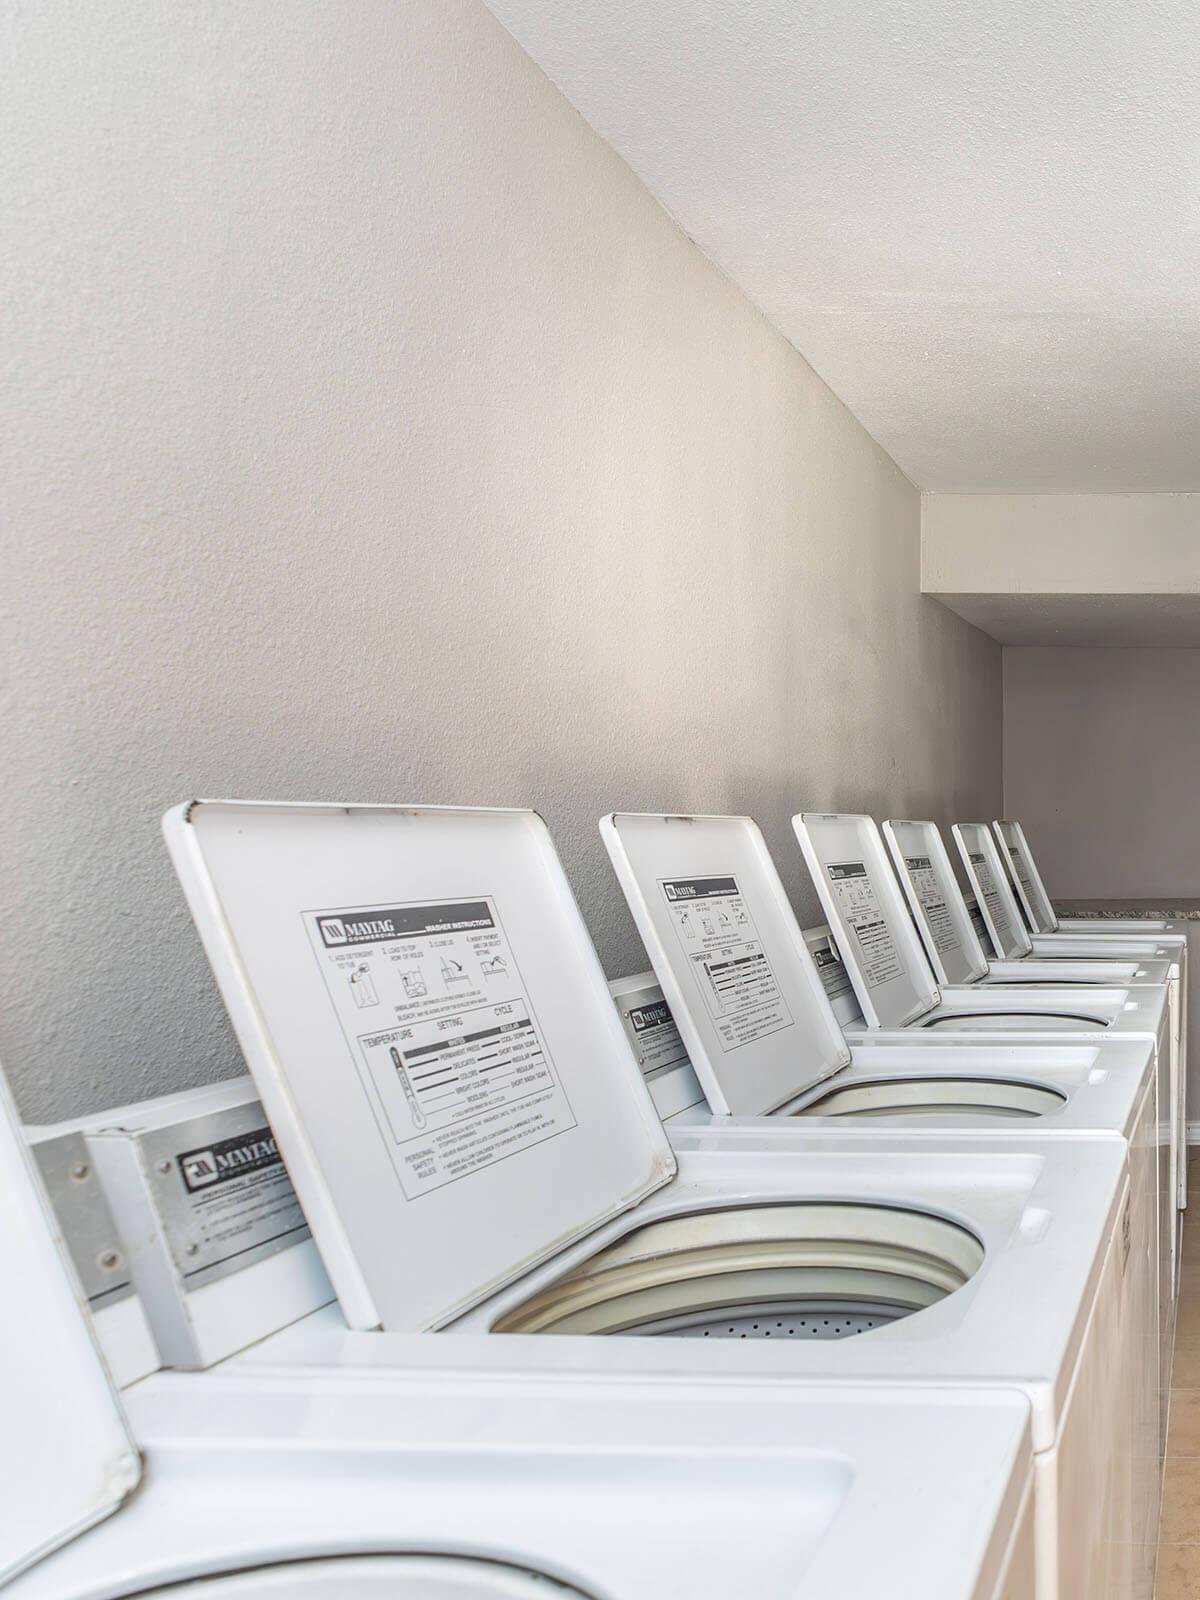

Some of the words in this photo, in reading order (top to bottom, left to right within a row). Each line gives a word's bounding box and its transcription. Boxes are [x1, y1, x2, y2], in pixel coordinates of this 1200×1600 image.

[344, 919, 395, 936] MAYTAG
[424, 923, 451, 932] WASHER
[451, 918, 492, 929] INSTRUCTIONS
[492, 1004, 513, 1016] CYCLE
[436, 1016, 463, 1030] SETTING
[362, 1028, 414, 1049] TEMPERATURE
[411, 1156, 434, 1171] SAFETY
[417, 1166, 436, 1179] RULES
